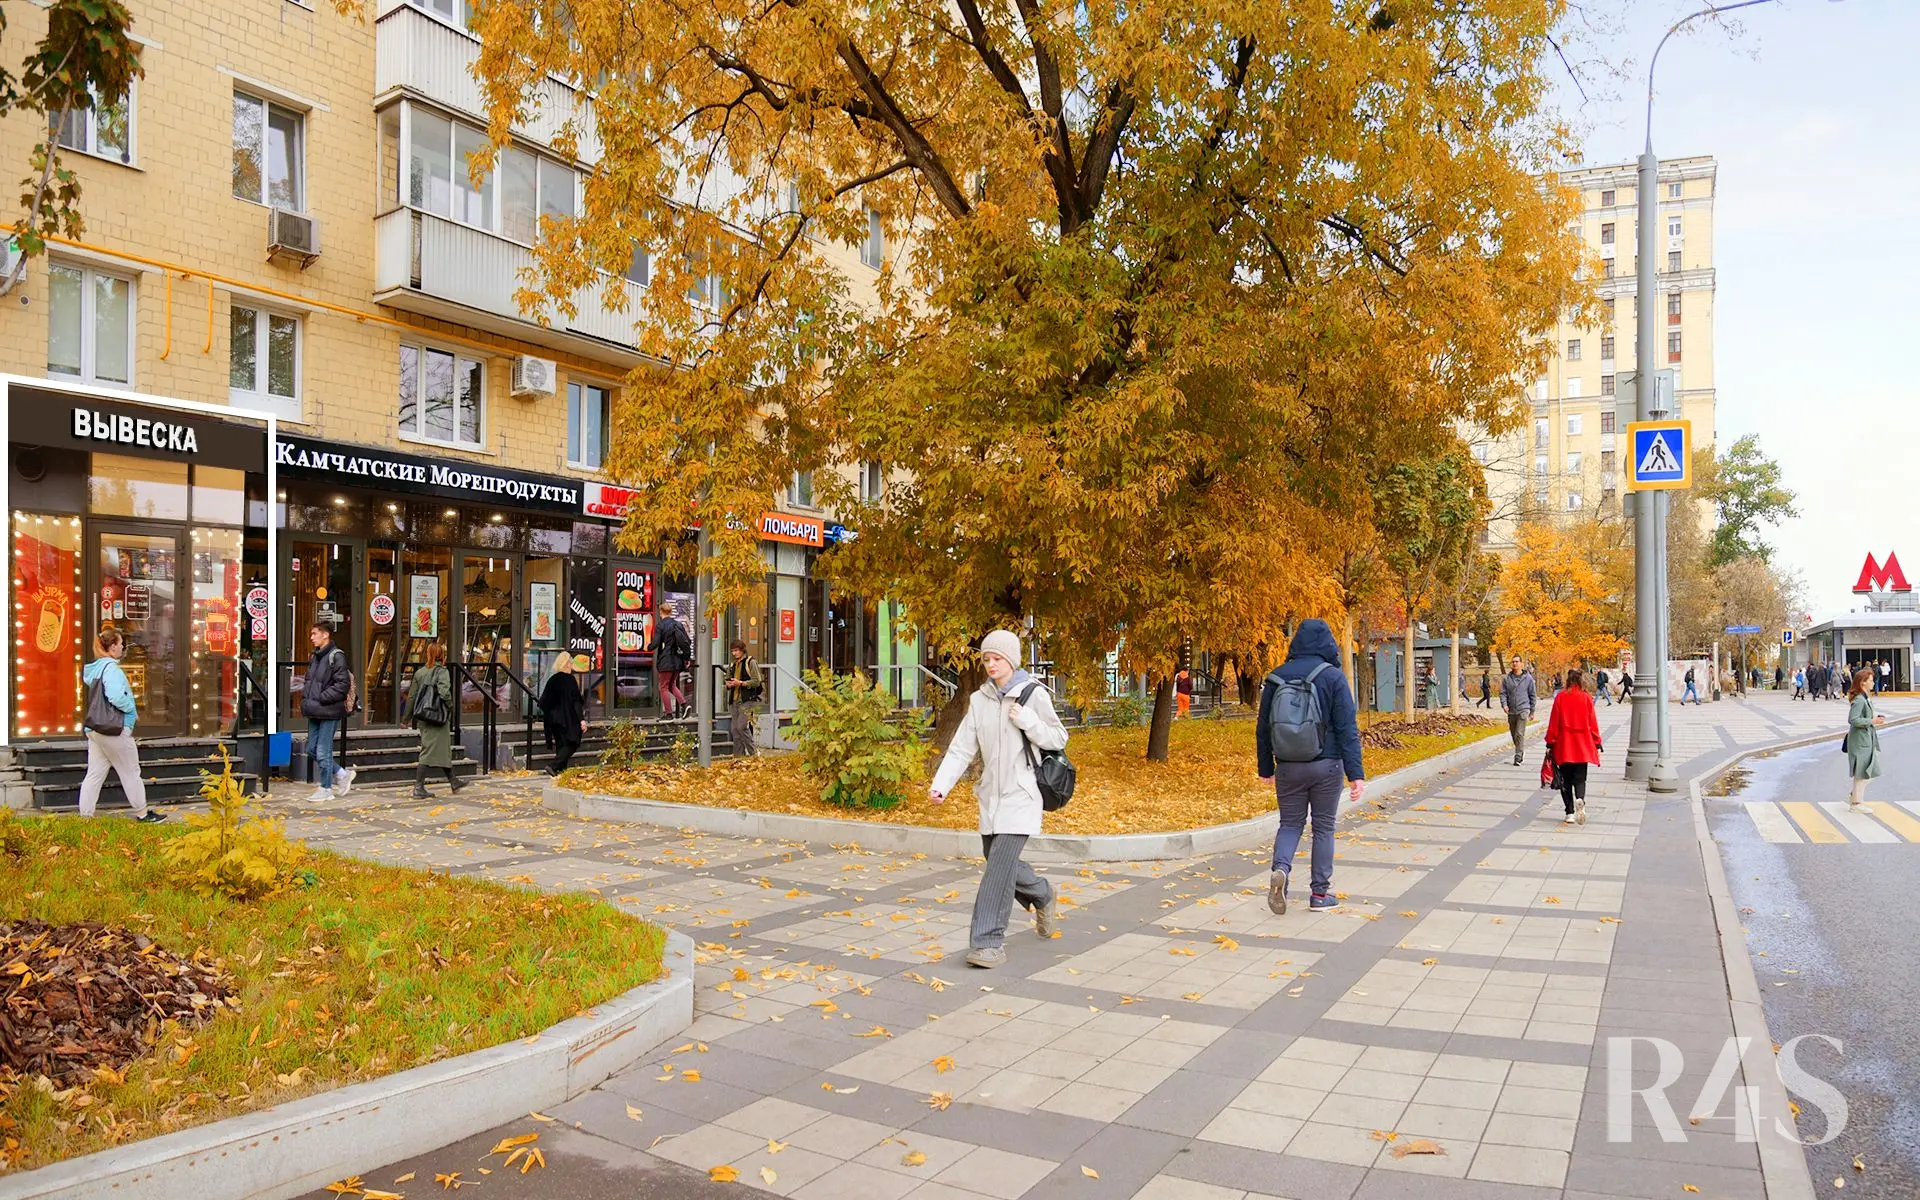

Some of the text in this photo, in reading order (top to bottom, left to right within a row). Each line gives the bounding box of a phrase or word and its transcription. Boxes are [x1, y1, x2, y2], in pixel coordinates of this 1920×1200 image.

[73, 407, 198, 453] ВЫВЕСКА
[276, 441, 578, 504] КАМЧАТСКИЕ МОРЕПРОДУКТЫ
[763, 517, 818, 542] ЛОМБАРД
[31, 585, 69, 606] ШАУРМА
[616, 571, 644, 591] 200р
[569, 598, 605, 637] ШАУРМА
